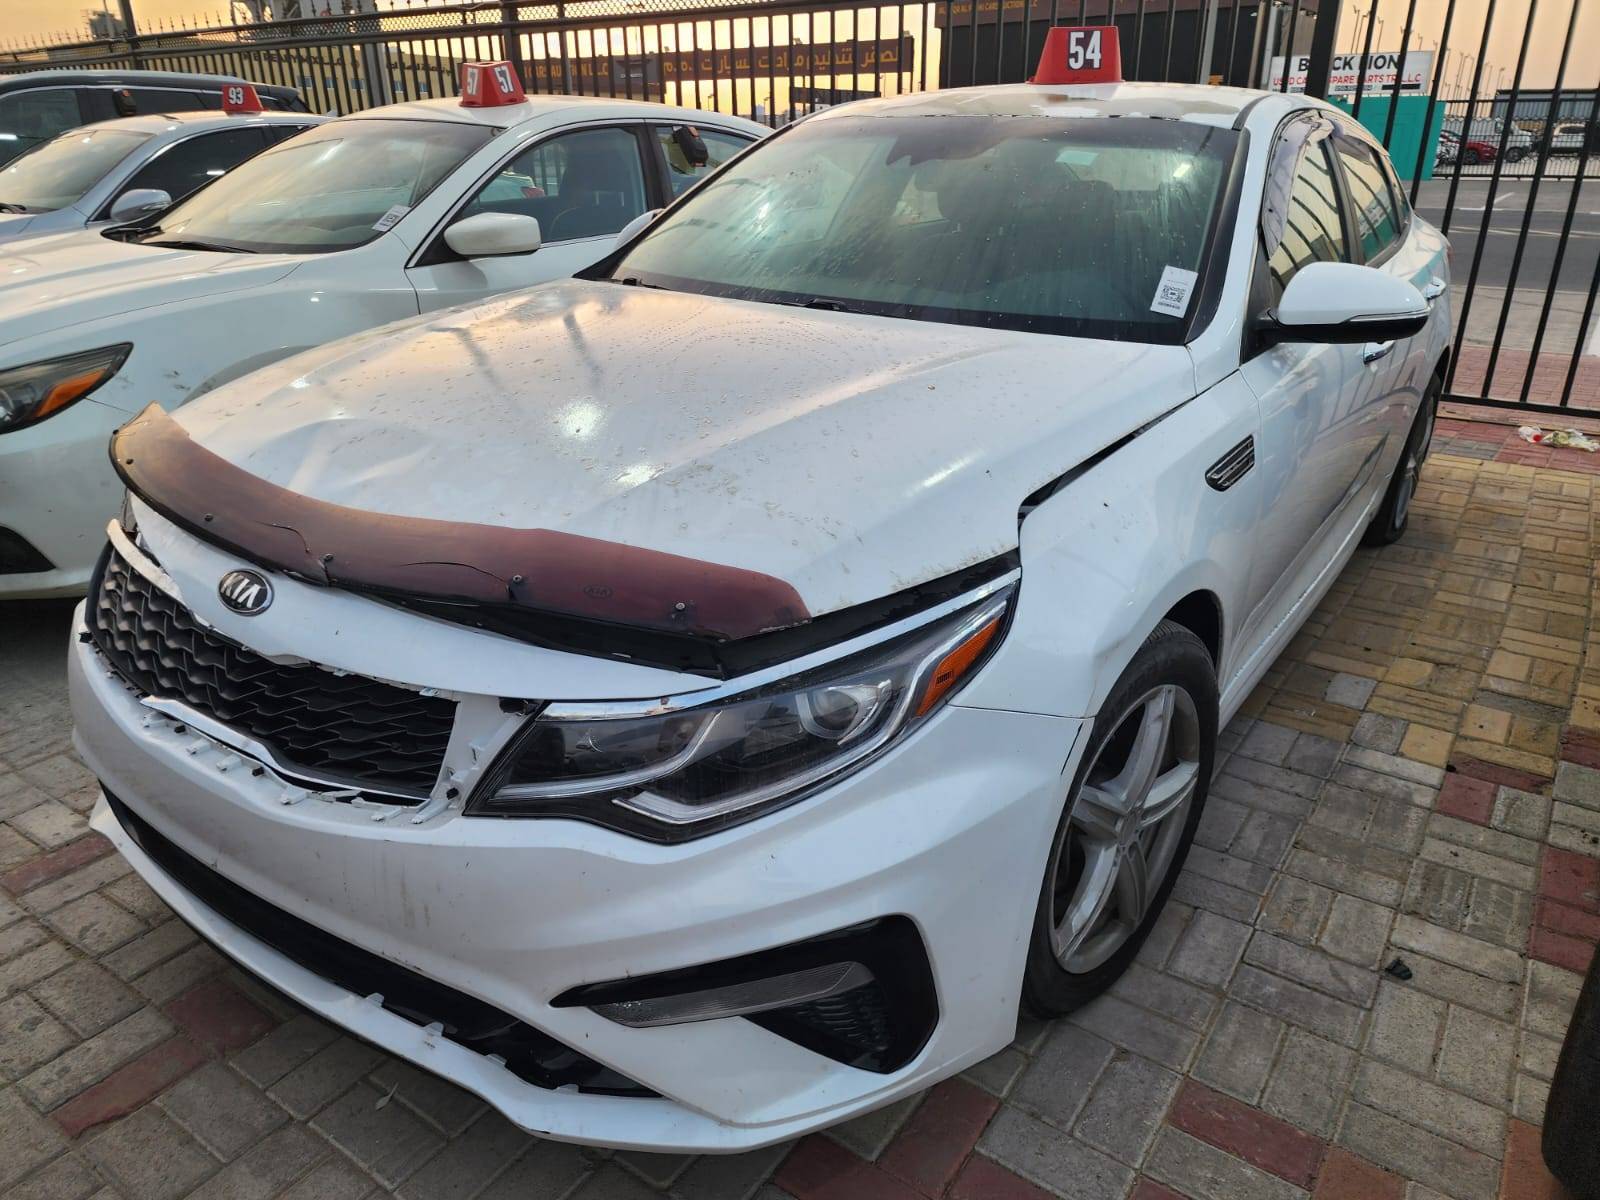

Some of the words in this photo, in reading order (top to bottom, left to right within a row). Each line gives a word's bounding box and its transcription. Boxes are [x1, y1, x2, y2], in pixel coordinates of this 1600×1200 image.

[1068, 30, 1102, 70] 54
[1298, 56, 1355, 72] BCK
[1359, 54, 1402, 70] ION
[466, 68, 479, 96] 57
[494, 65, 515, 94] 57
[1273, 77, 1295, 86] USD
[1359, 75, 1384, 83] ARTS
[228, 87, 244, 105] 93
[220, 572, 261, 609] KIA
